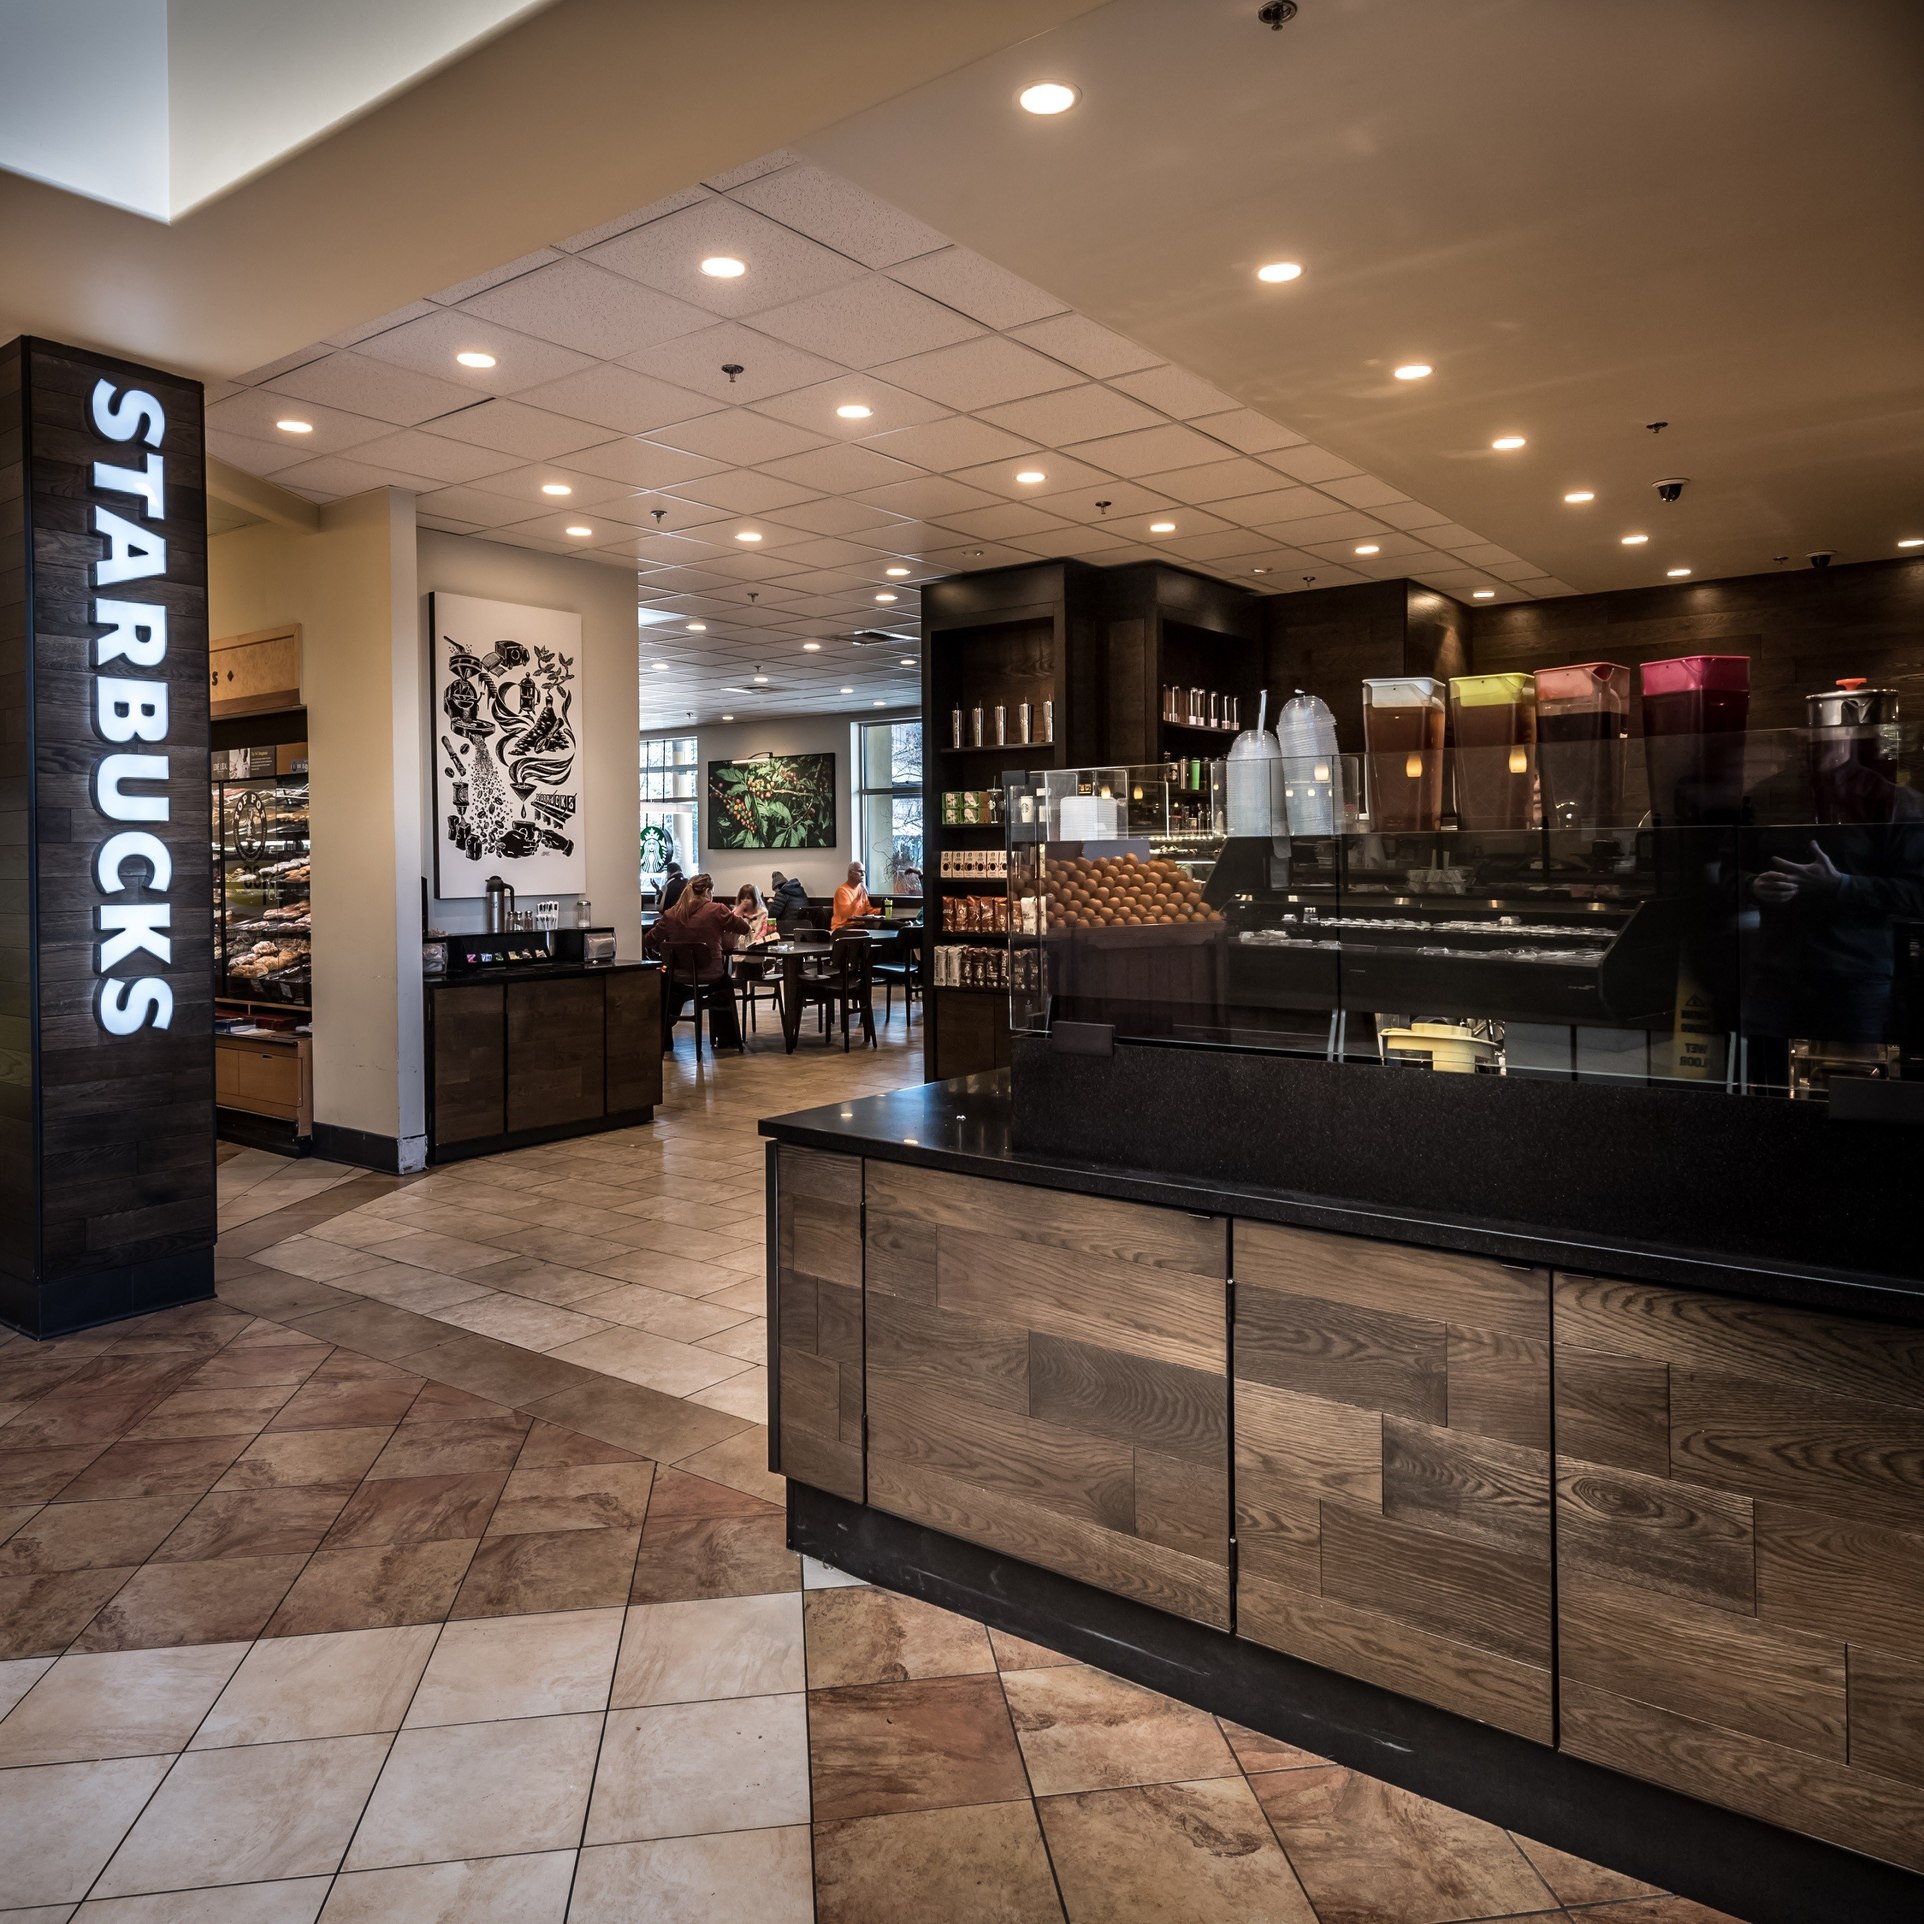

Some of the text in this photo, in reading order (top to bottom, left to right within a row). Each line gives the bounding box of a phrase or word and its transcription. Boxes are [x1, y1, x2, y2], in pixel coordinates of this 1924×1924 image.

[92, 378, 174, 1037] STARBUCKS
[234, 794, 266, 820] TOP POT
